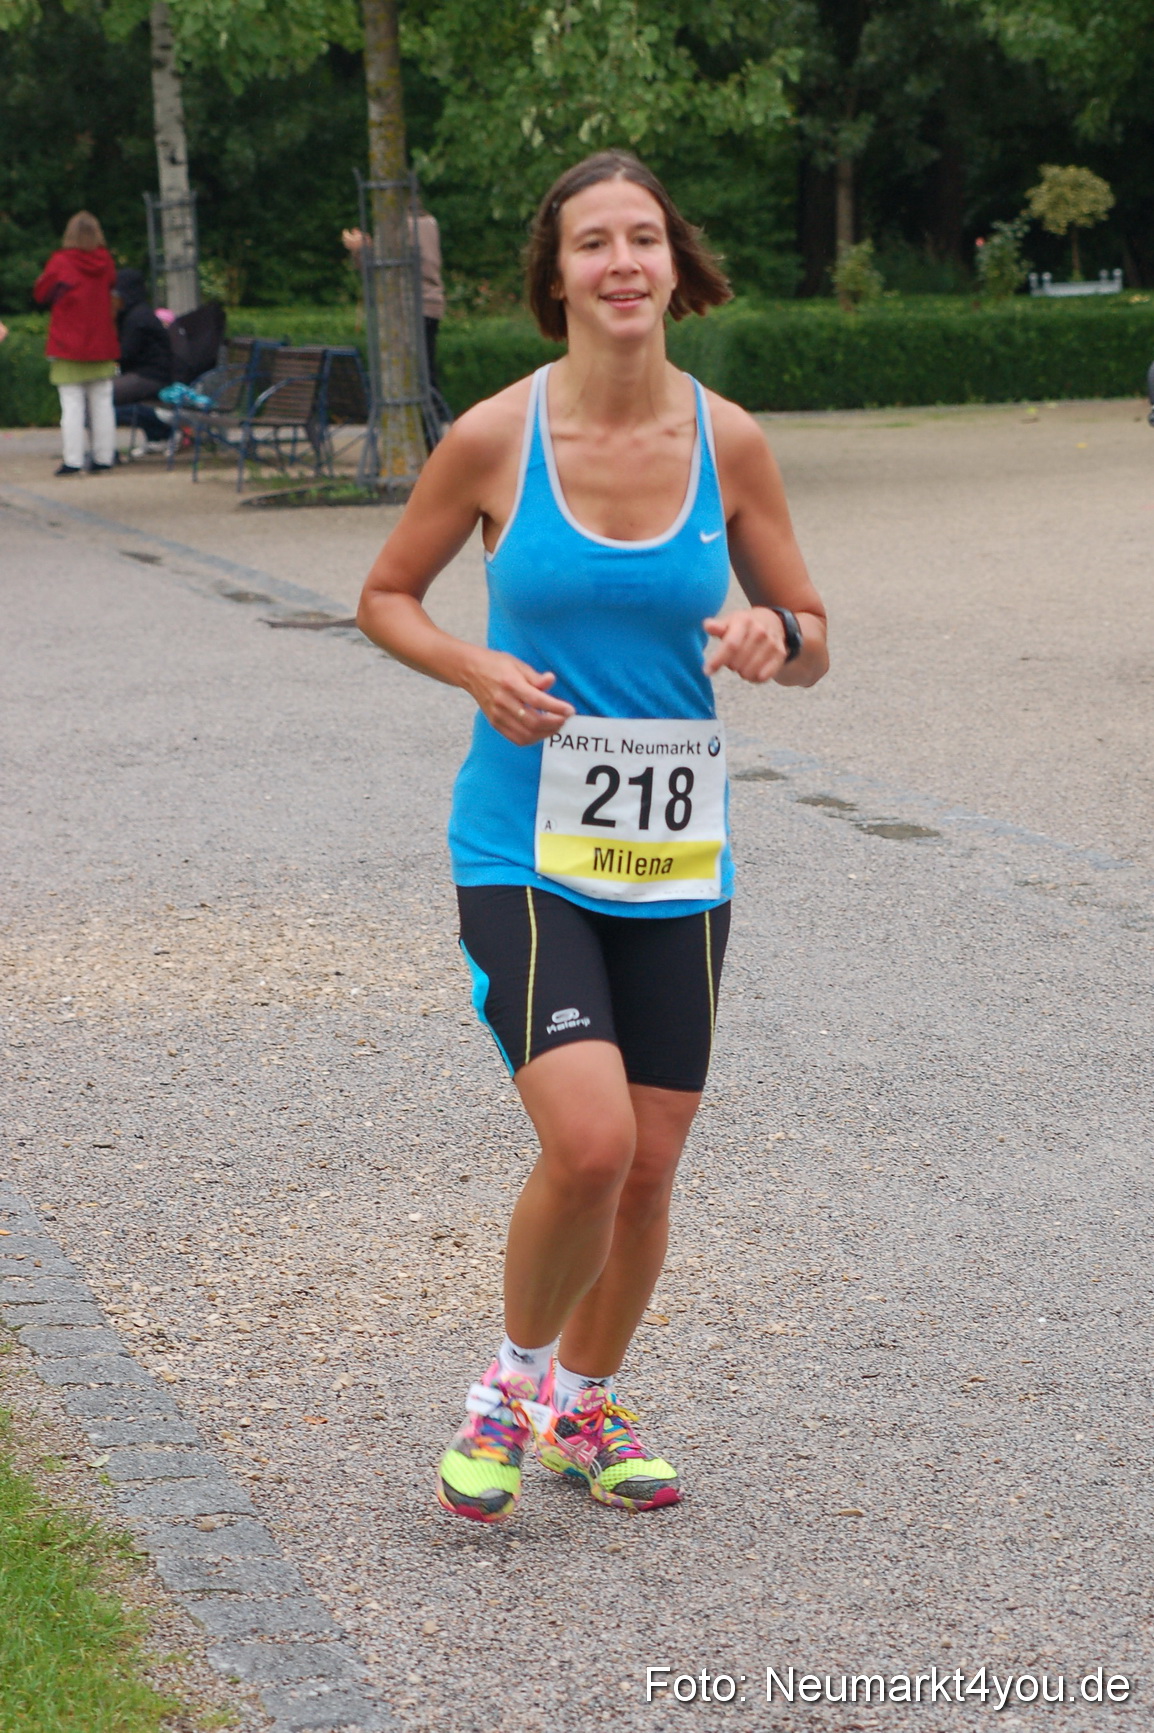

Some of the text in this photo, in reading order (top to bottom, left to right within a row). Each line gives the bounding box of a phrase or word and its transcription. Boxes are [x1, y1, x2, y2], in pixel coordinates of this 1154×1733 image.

[549, 733, 701, 755] PARTL Neumarkt
[581, 765, 695, 831] 218
[543, 820, 552, 831] A
[593, 847, 674, 876] Milena
